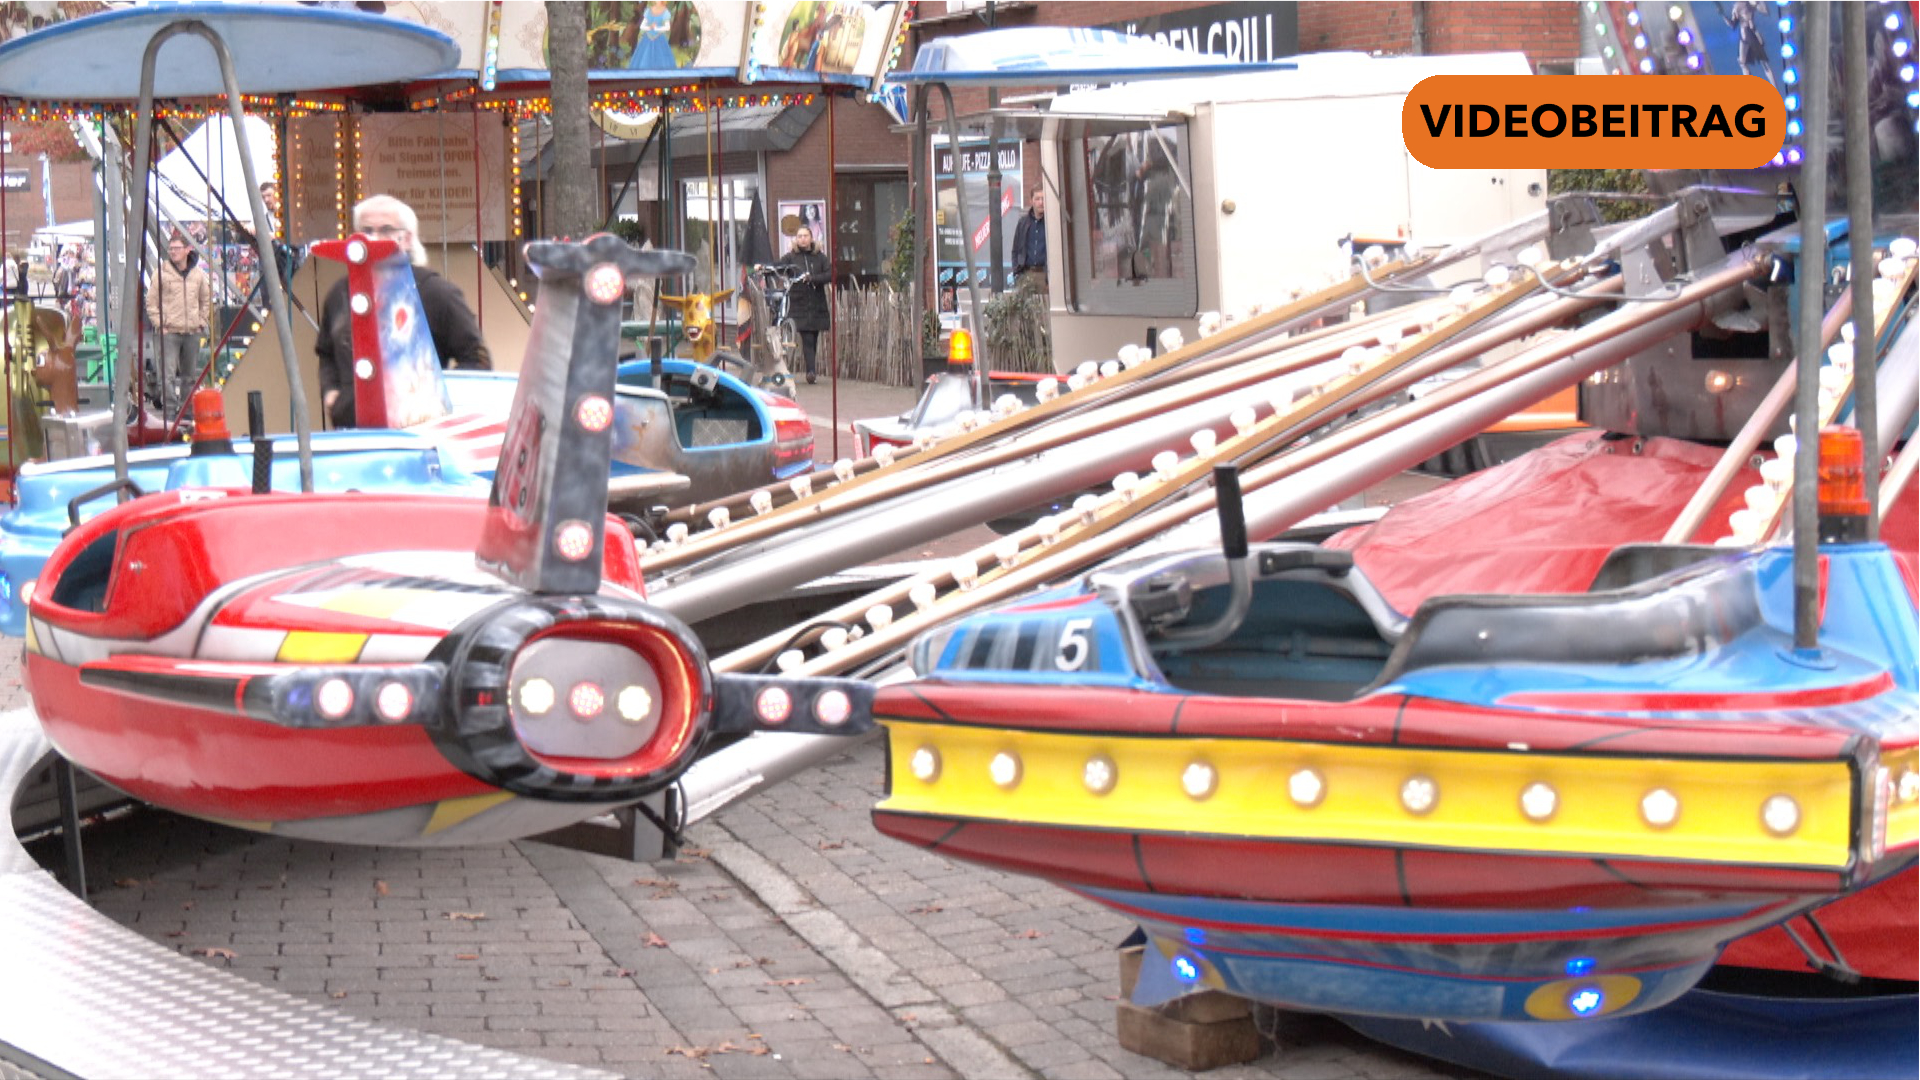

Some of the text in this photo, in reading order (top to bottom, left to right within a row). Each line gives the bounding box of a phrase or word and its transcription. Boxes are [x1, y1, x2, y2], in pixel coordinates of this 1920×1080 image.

[388, 137, 414, 147] Bitte
[379, 153, 396, 163] bei
[399, 152, 433, 164] Signal
[1055, 618, 1093, 672] 5
